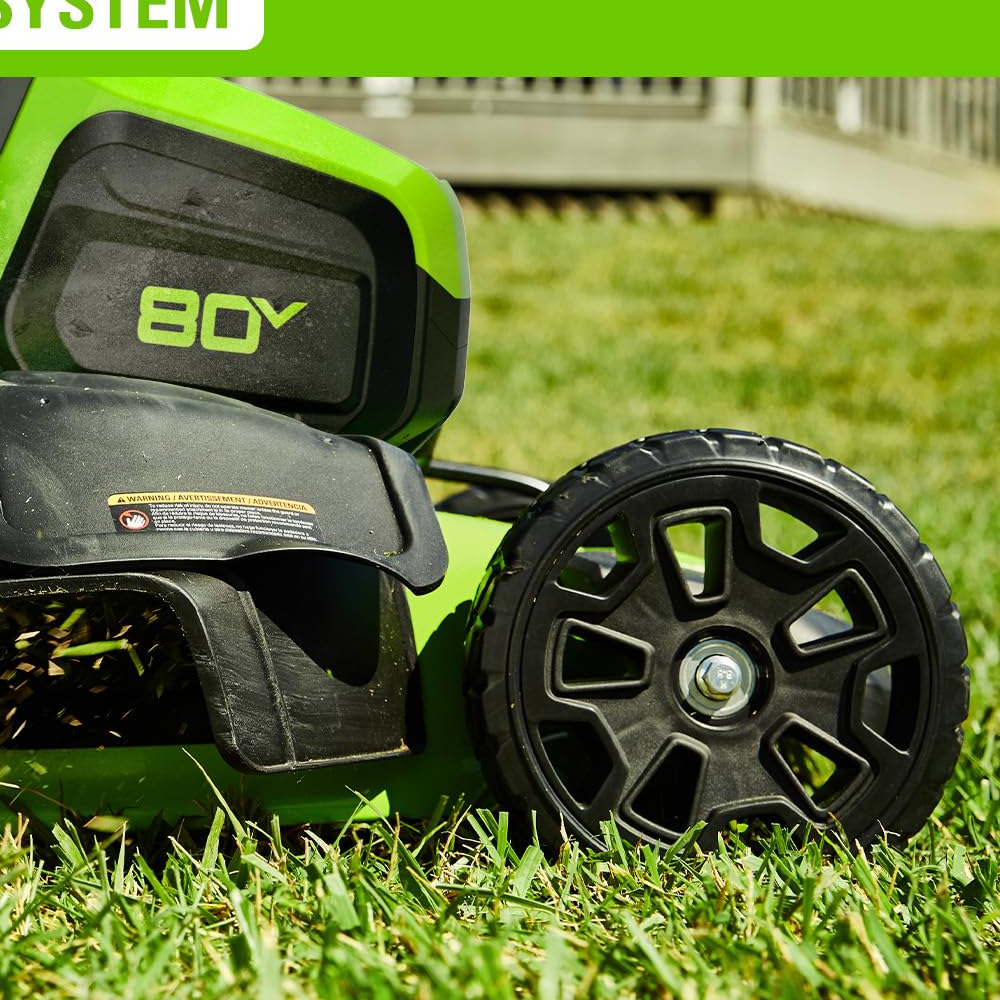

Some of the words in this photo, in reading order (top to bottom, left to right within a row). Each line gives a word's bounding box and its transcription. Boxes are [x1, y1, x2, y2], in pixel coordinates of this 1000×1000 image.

[137, 285, 309, 355] 80V
[127, 494, 171, 502] WARNING
[178, 494, 246, 503] AVERTISSEMENT
[253, 498, 308, 511] ADVERTENCIA
